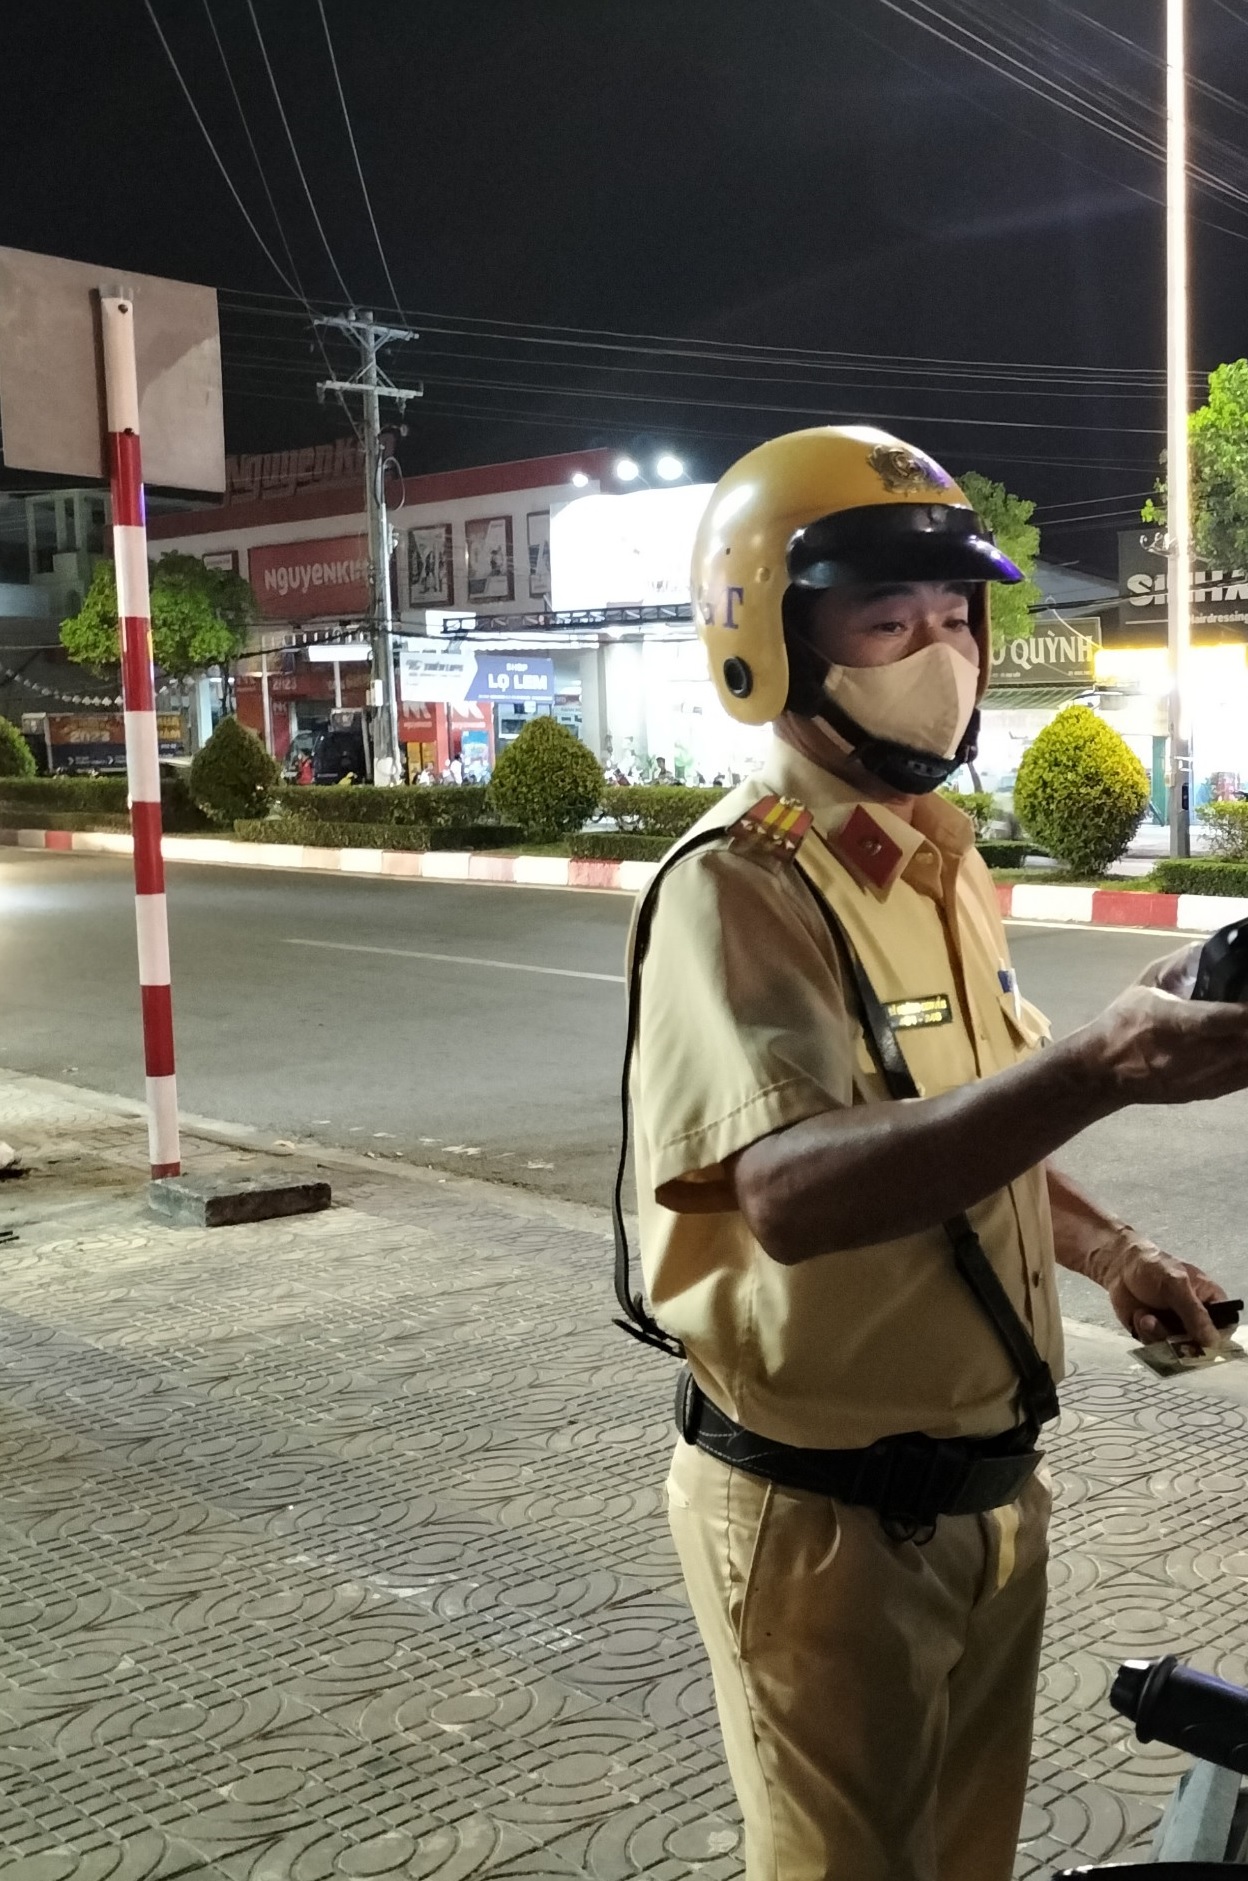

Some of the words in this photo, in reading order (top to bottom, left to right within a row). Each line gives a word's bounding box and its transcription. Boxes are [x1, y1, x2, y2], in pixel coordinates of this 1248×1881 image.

[1010, 629, 1094, 671] QUỲNH
[488, 673, 510, 692] LỌ
[513, 674, 548, 691] LEM
